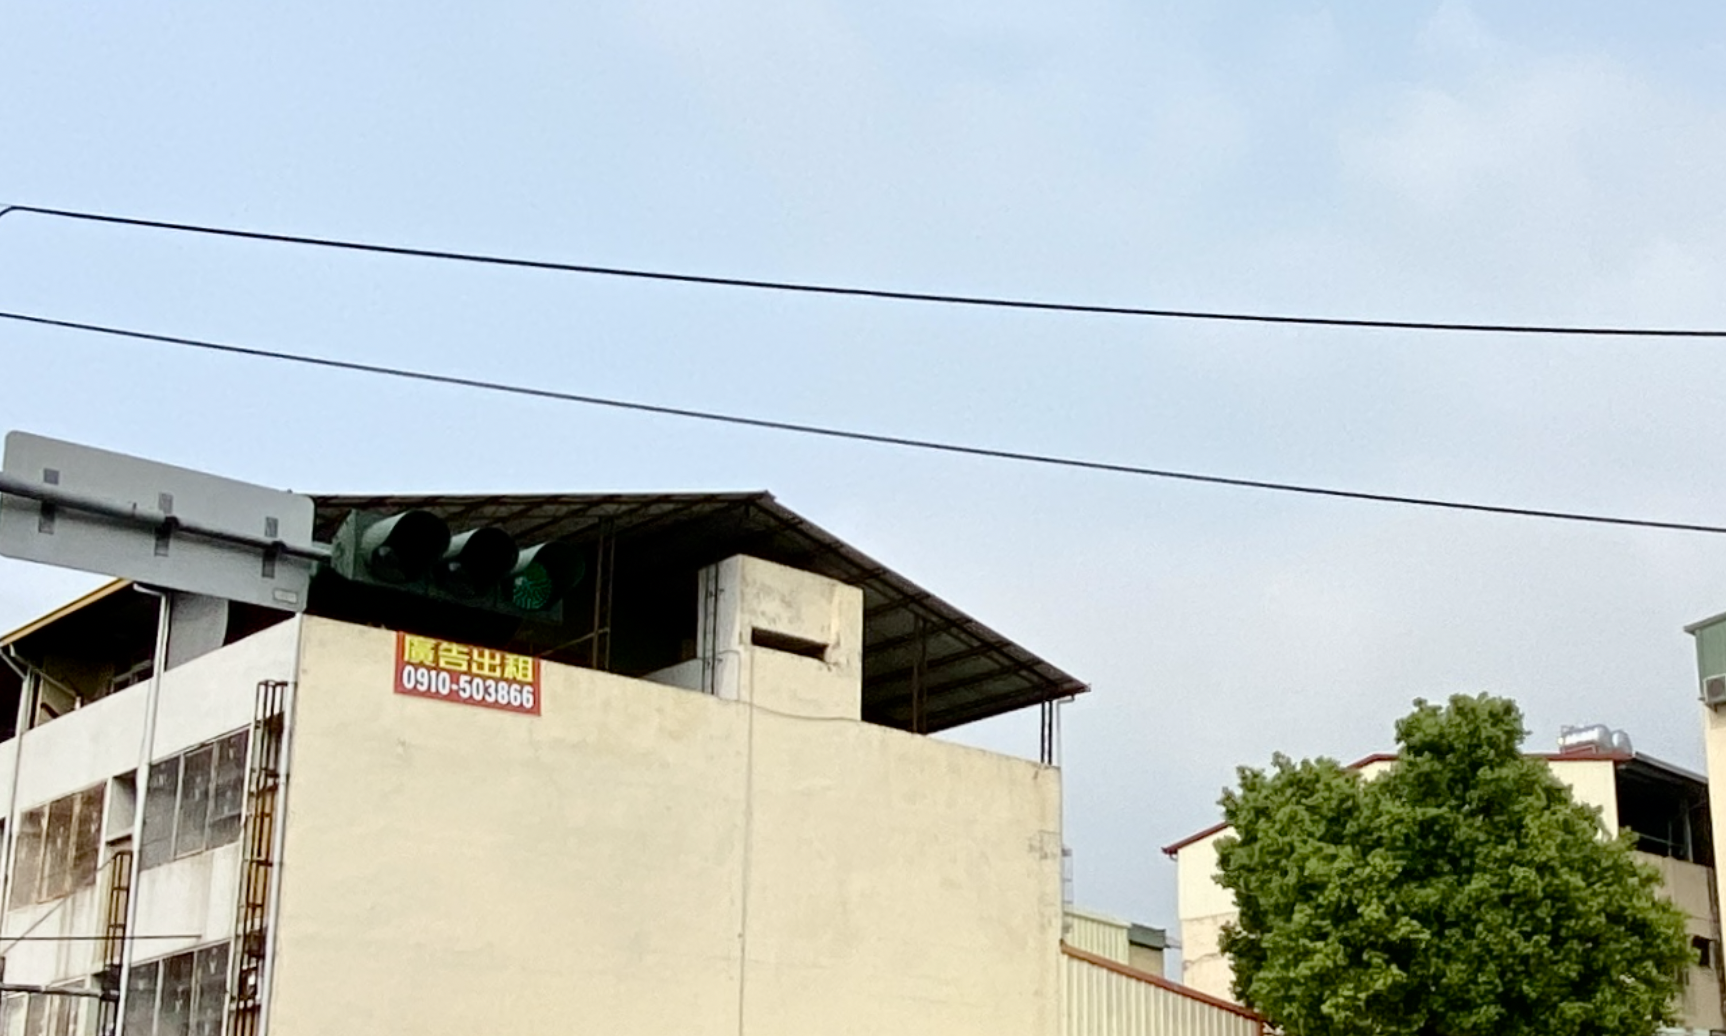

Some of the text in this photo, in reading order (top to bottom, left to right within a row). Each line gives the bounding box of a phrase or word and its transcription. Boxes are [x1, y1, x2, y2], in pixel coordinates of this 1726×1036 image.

[404, 634, 534, 682] 廣告出租
[402, 665, 534, 708] 0910-503866
